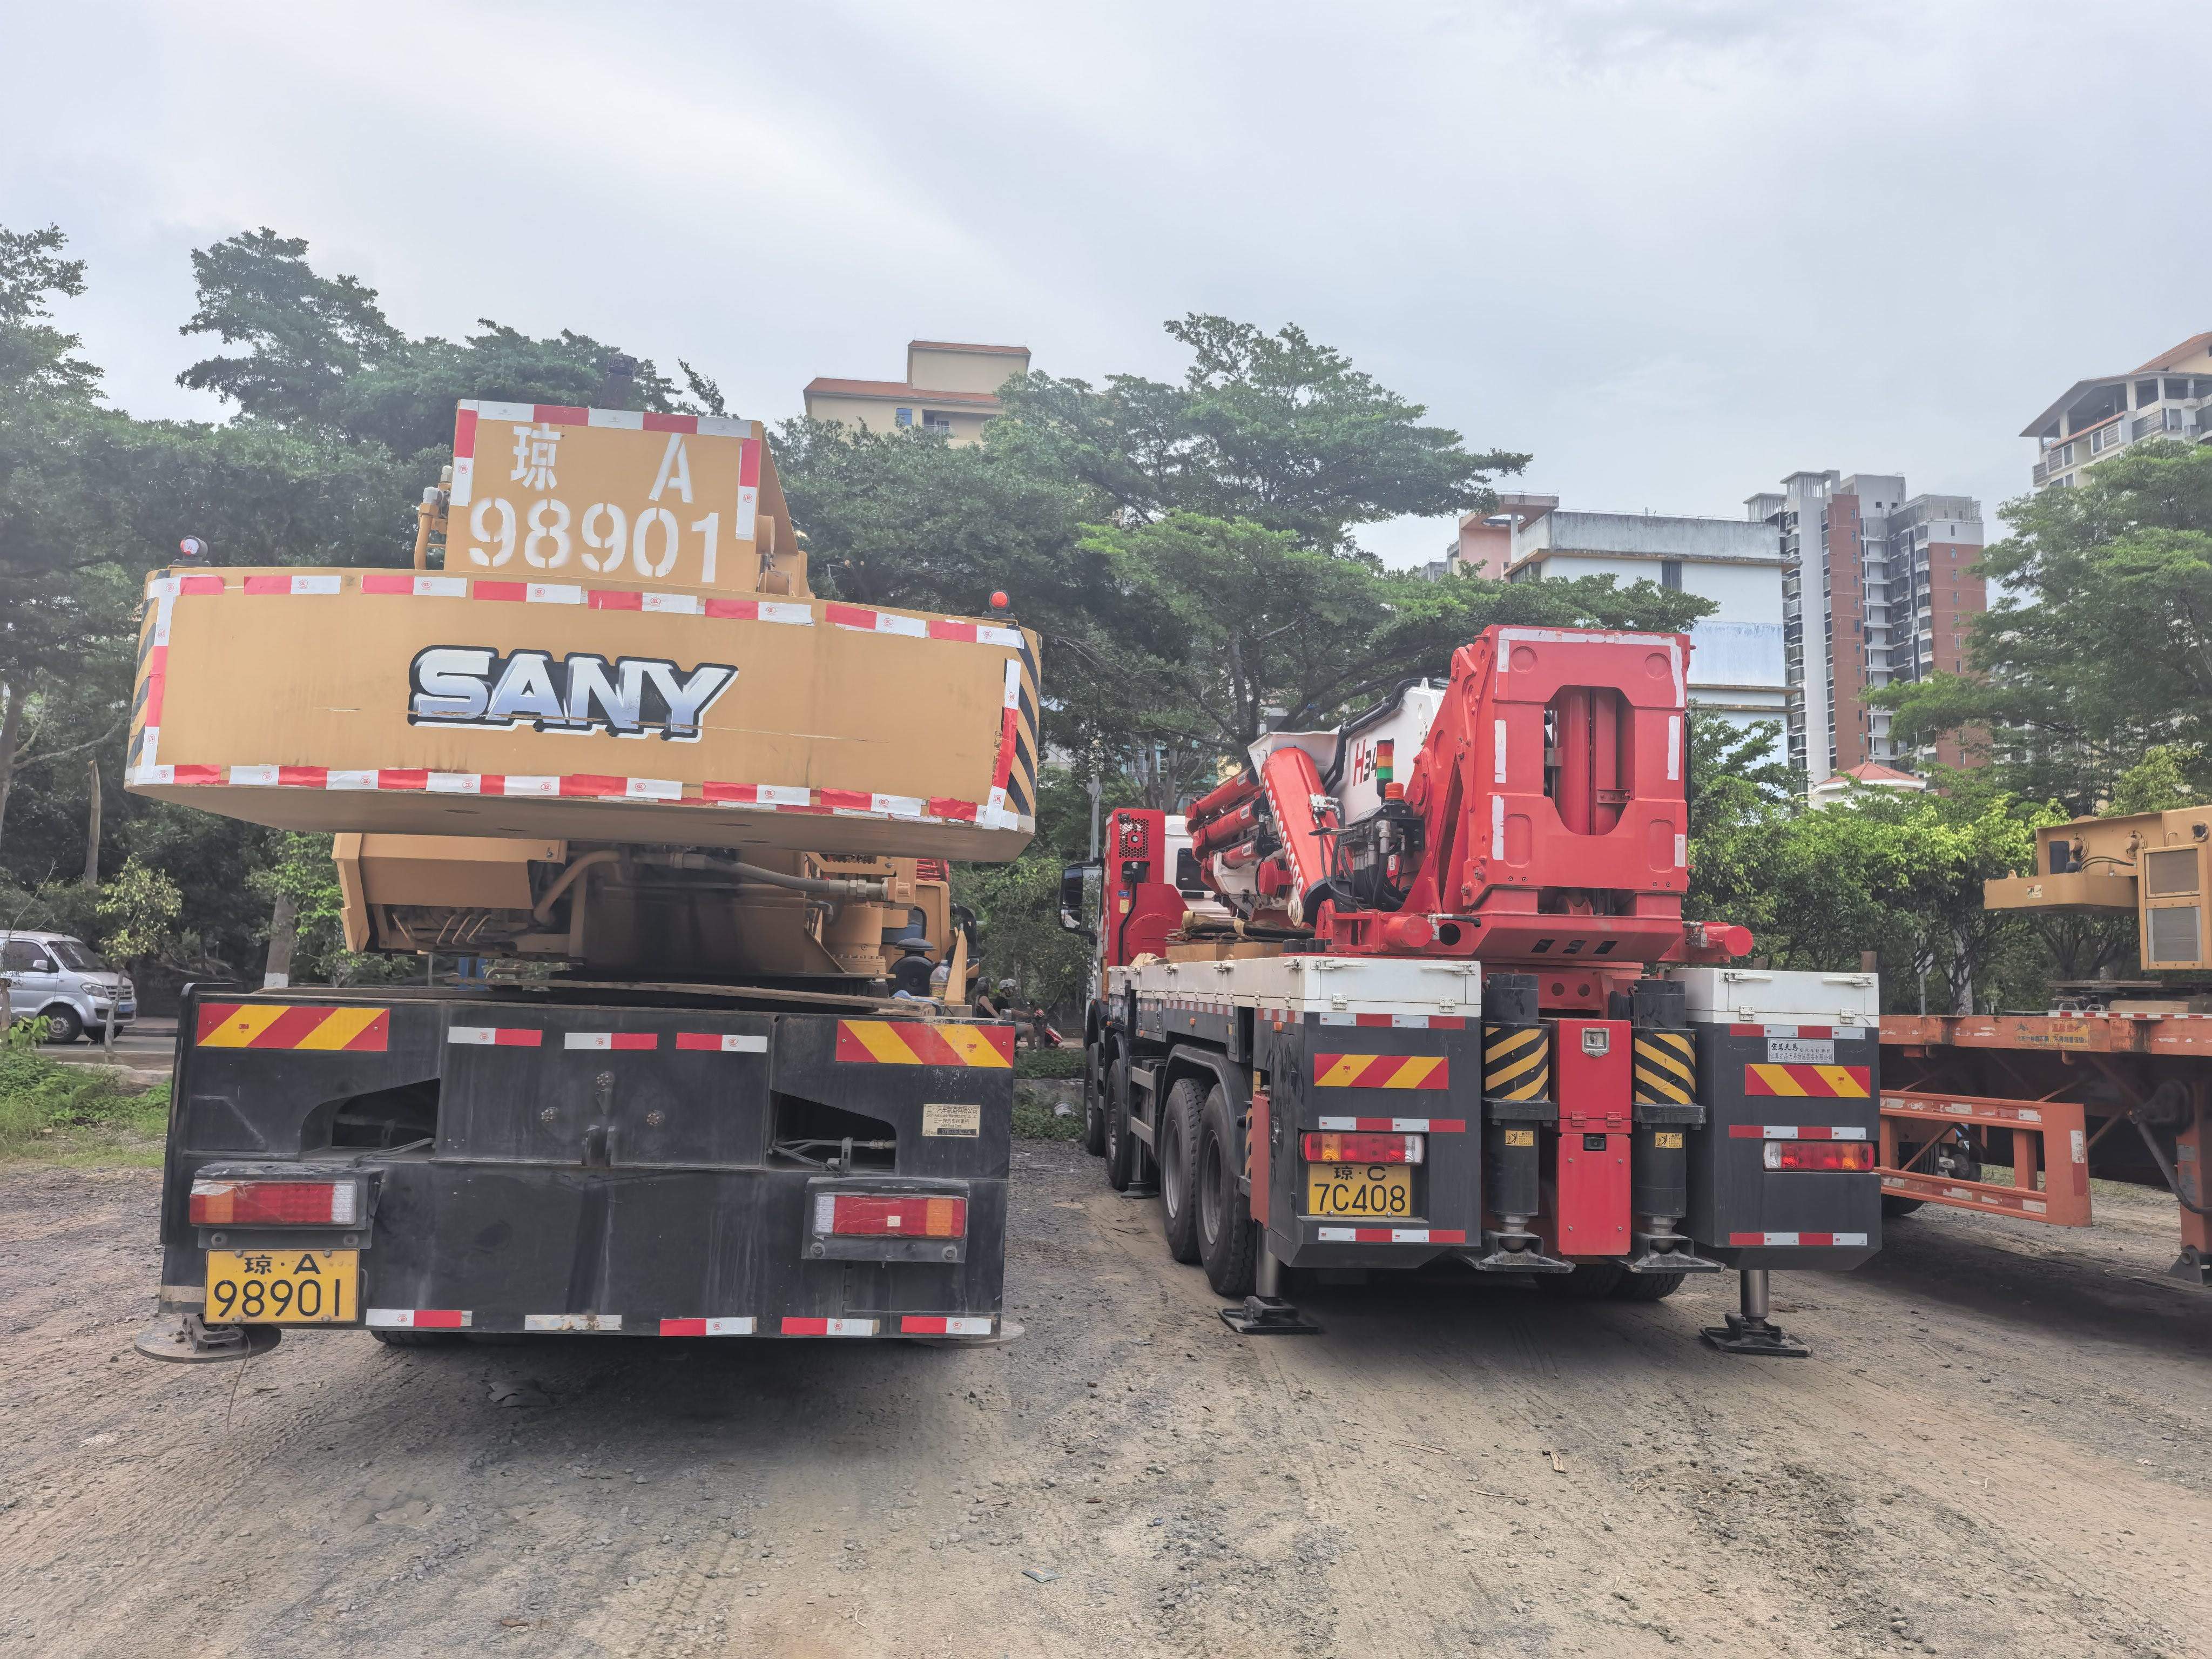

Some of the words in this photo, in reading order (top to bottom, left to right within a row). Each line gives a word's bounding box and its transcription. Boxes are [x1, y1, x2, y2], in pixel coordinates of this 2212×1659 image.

[510, 423, 561, 491] 琼
[649, 433, 693, 504] A
[469, 496, 719, 583] 98901
[408, 645, 737, 742] SANY
[1314, 1183, 1406, 1213] 7C408
[214, 1278, 340, 1318] 98901
